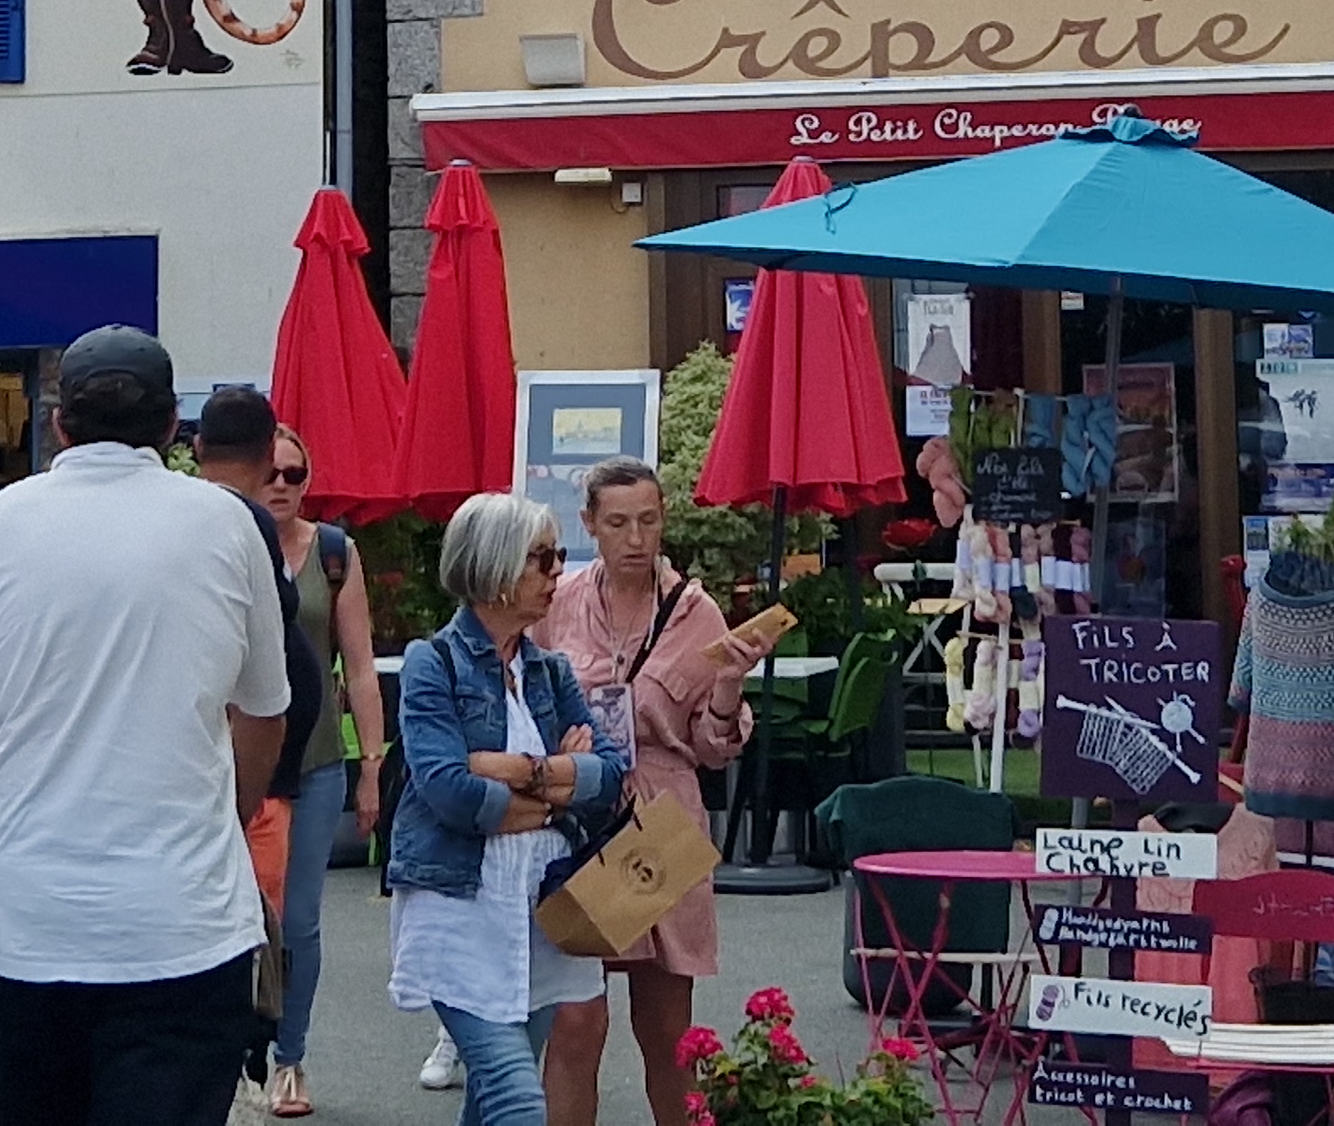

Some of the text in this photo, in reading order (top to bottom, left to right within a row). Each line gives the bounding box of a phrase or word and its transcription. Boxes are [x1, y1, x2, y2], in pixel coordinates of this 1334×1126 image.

[789, 113, 840, 145] Le
[848, 111, 923, 142] Petit
[1154, 621, 1178, 652] À
[1074, 982, 1212, 1036] Fils recyclés
[1035, 1084, 1193, 1111] tricot et crochet
